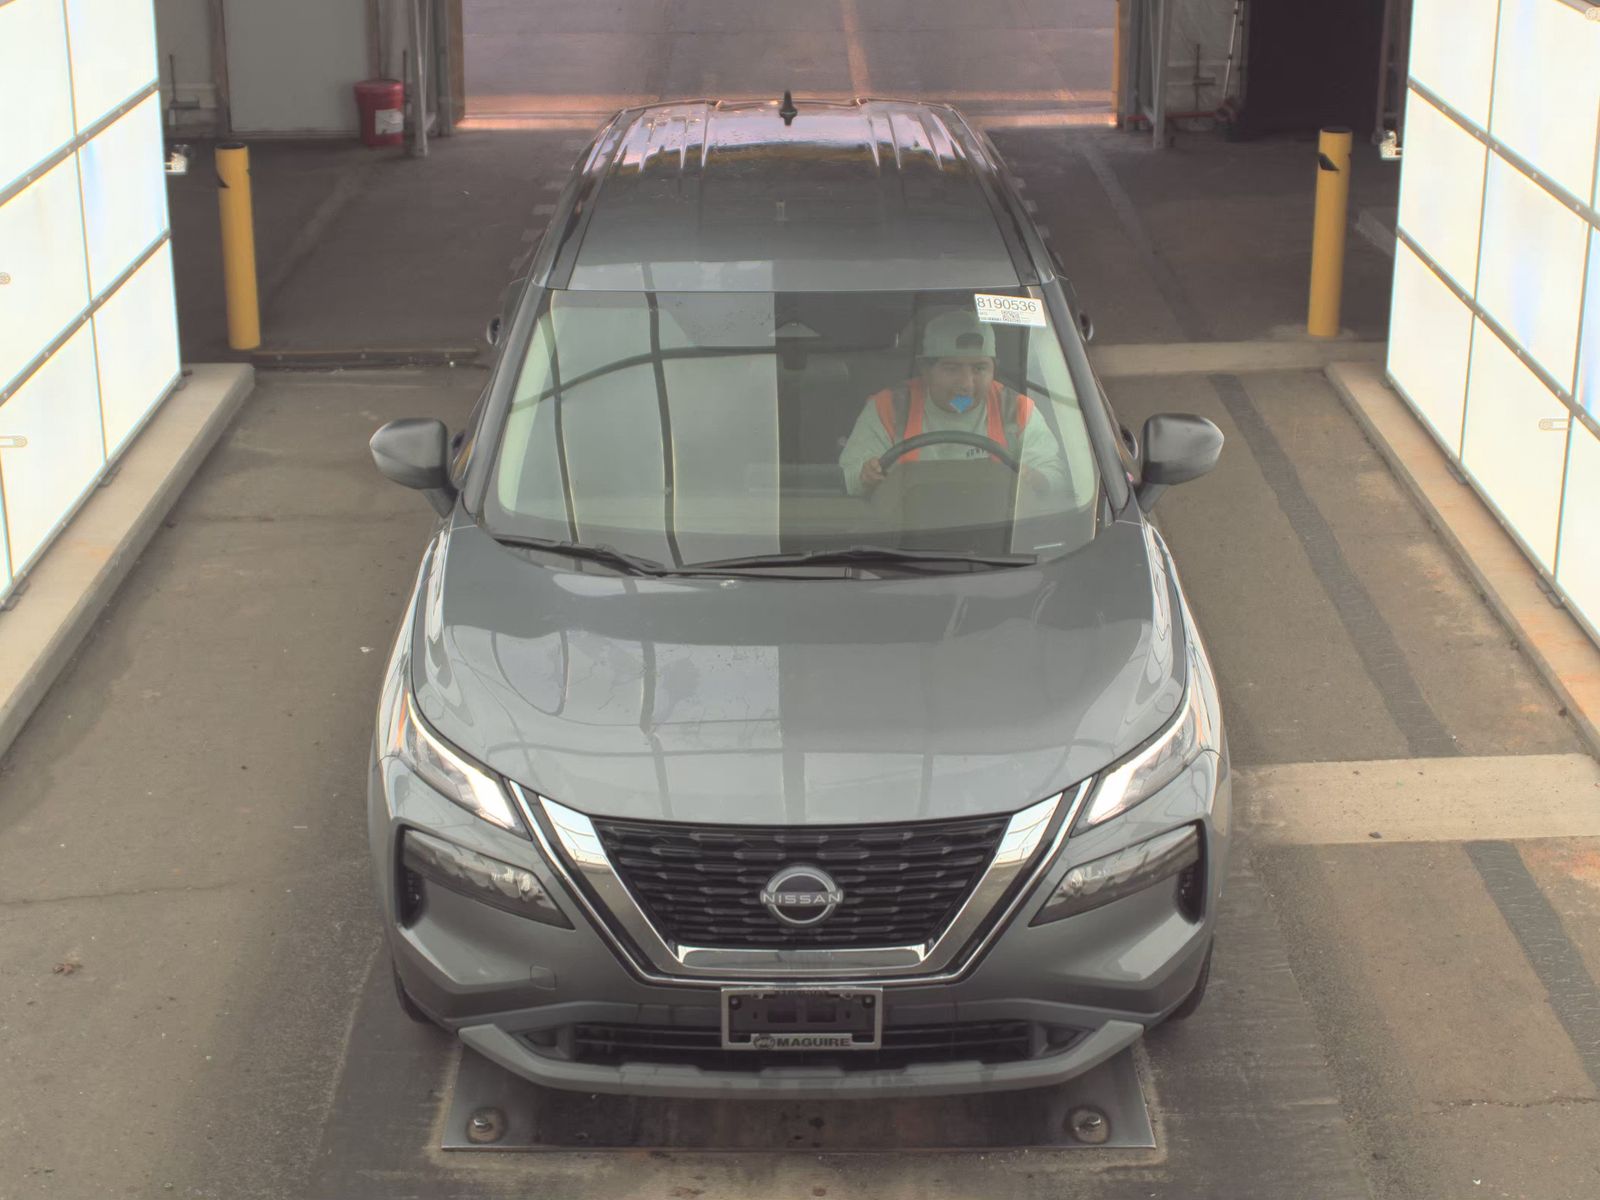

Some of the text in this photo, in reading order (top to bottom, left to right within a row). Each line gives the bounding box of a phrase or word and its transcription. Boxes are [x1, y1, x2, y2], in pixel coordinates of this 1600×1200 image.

[977, 297, 1037, 312] 8190536
[763, 893, 840, 904] NISSAN
[777, 1038, 850, 1047] MAGUIRE
